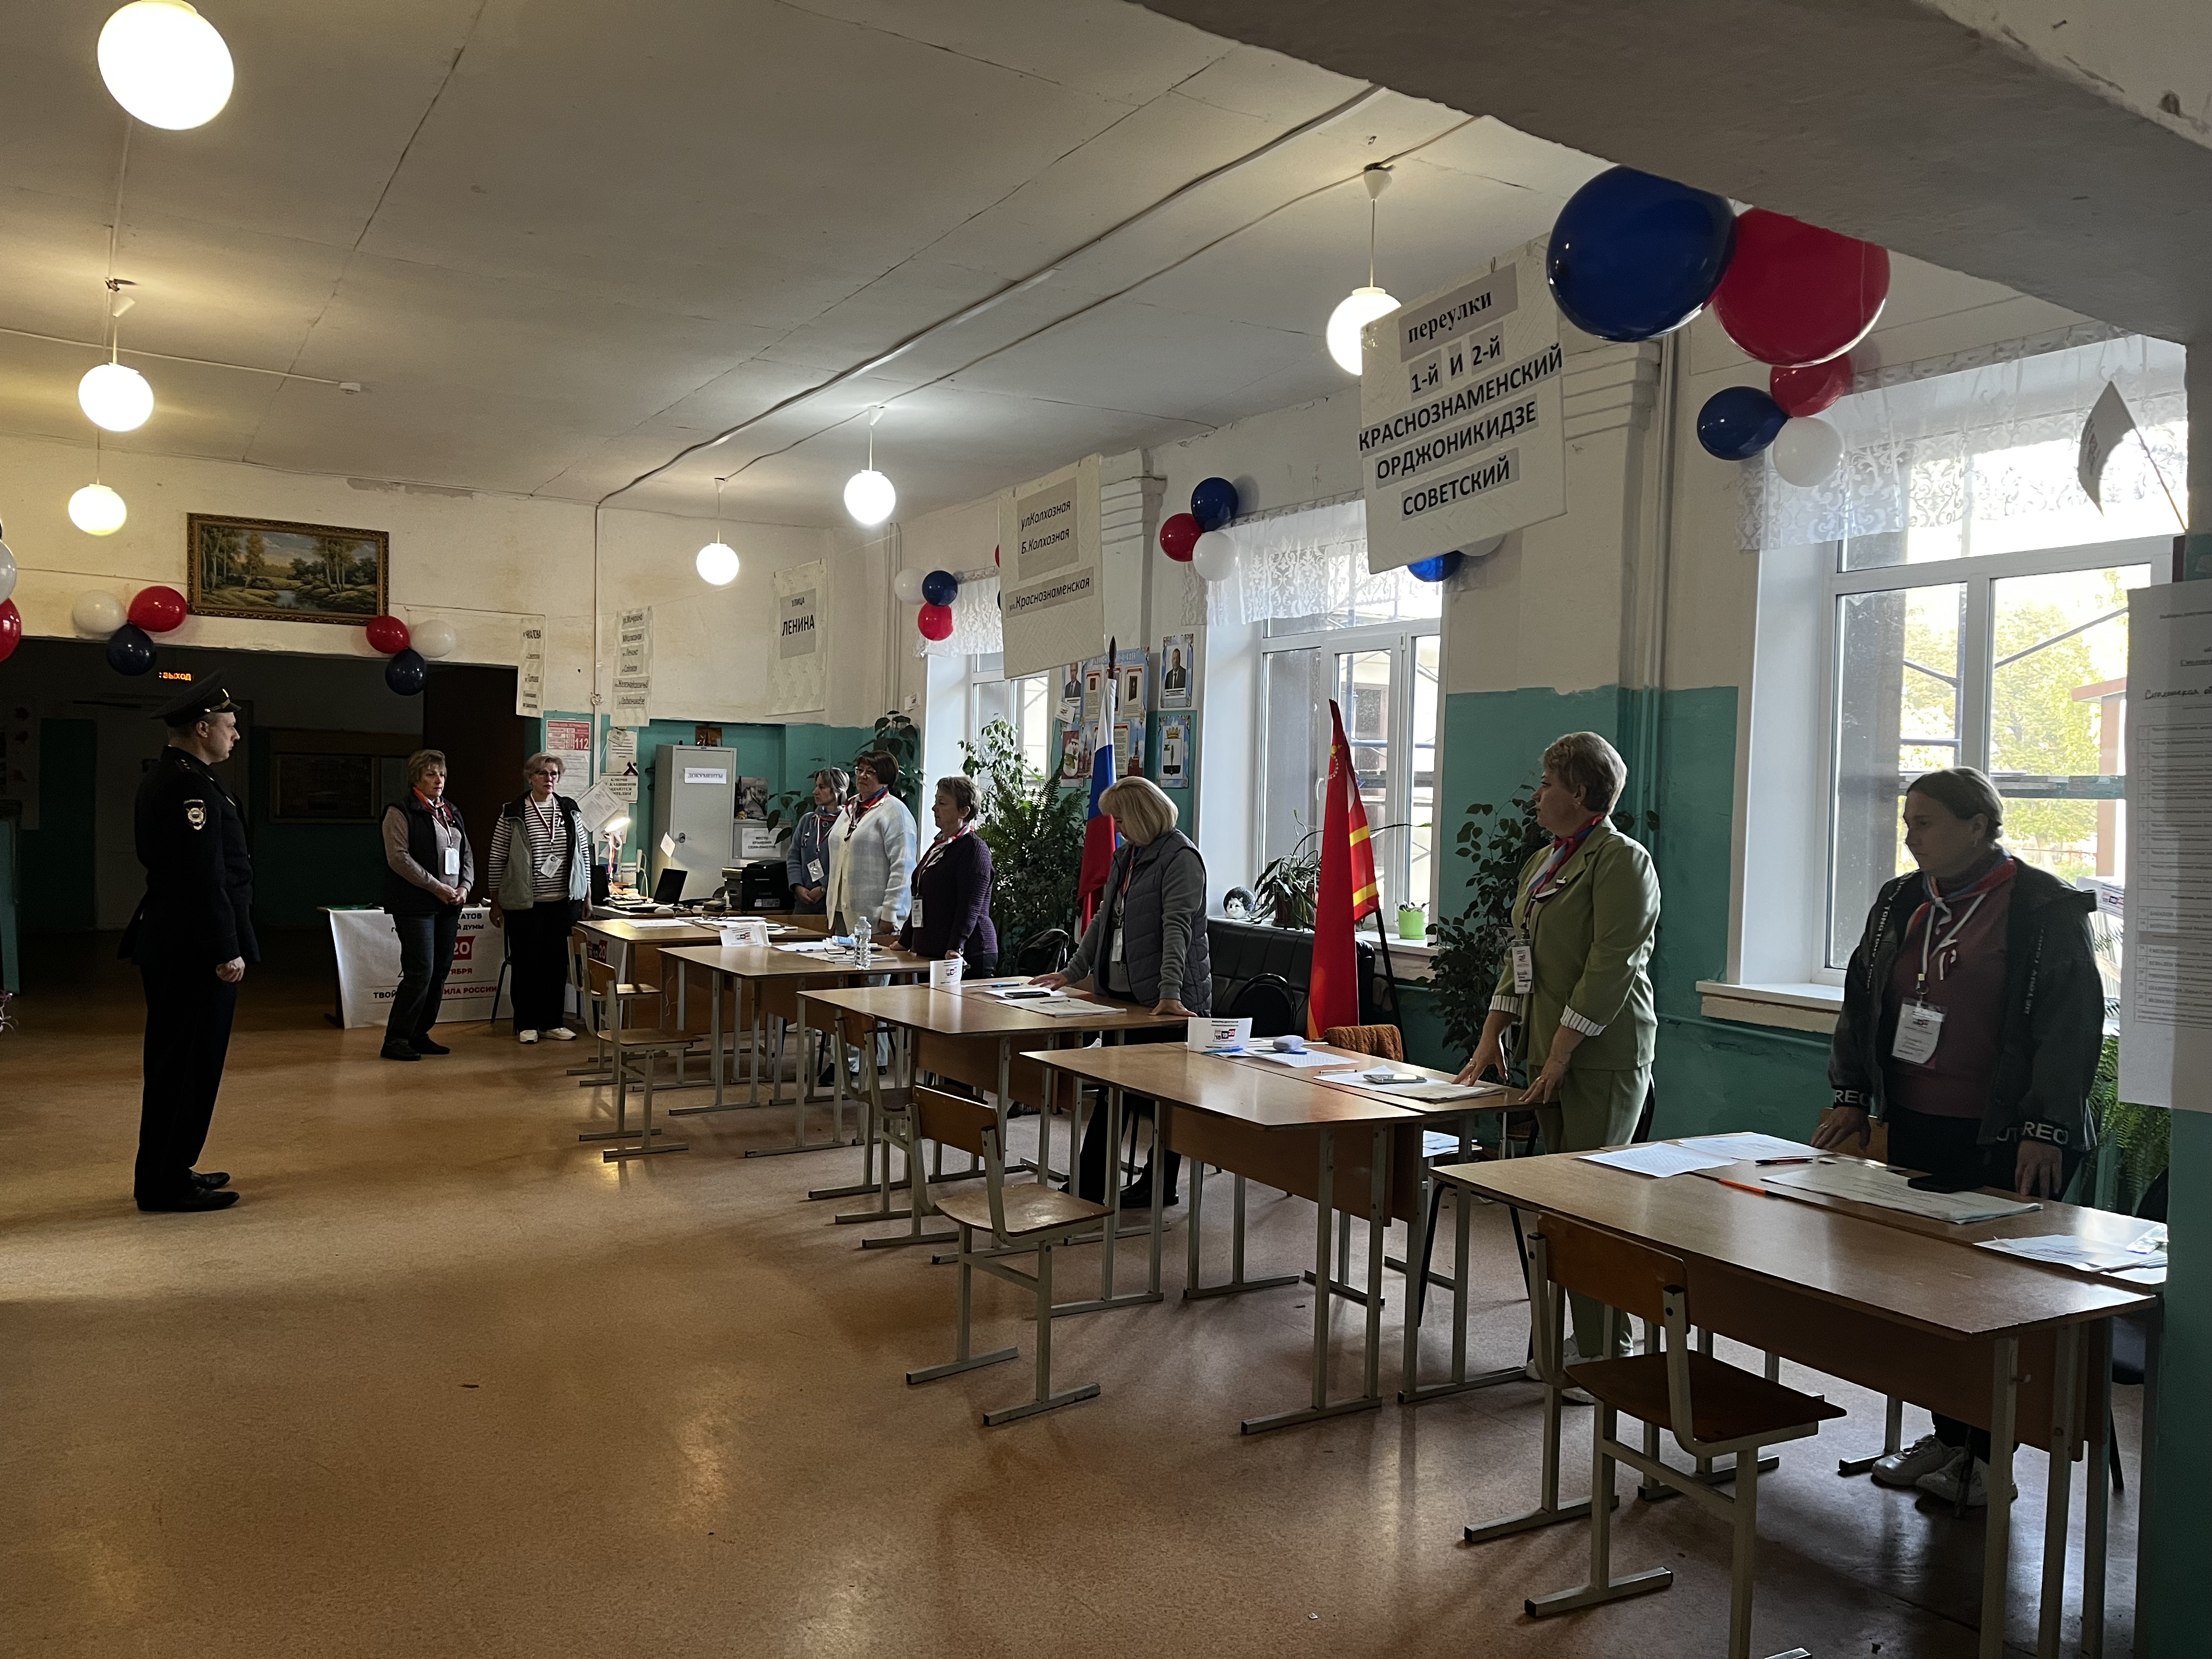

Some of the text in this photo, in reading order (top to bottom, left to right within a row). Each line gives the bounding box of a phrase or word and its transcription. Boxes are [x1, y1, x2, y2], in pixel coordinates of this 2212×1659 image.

[1408, 291, 1492, 343] переулки
[1412, 335, 1501, 393] 1-й И 2-й
[1359, 343, 1563, 452] КРАСНОЗНАМЕНСКИЙ
[1378, 401, 1537, 479] ОРДЖОНИКИДЗЕ
[1403, 455, 1510, 515] СОВЕТСКИЙ
[782, 614, 815, 636] ЛЕНИНА
[575, 738, 589, 749] 112
